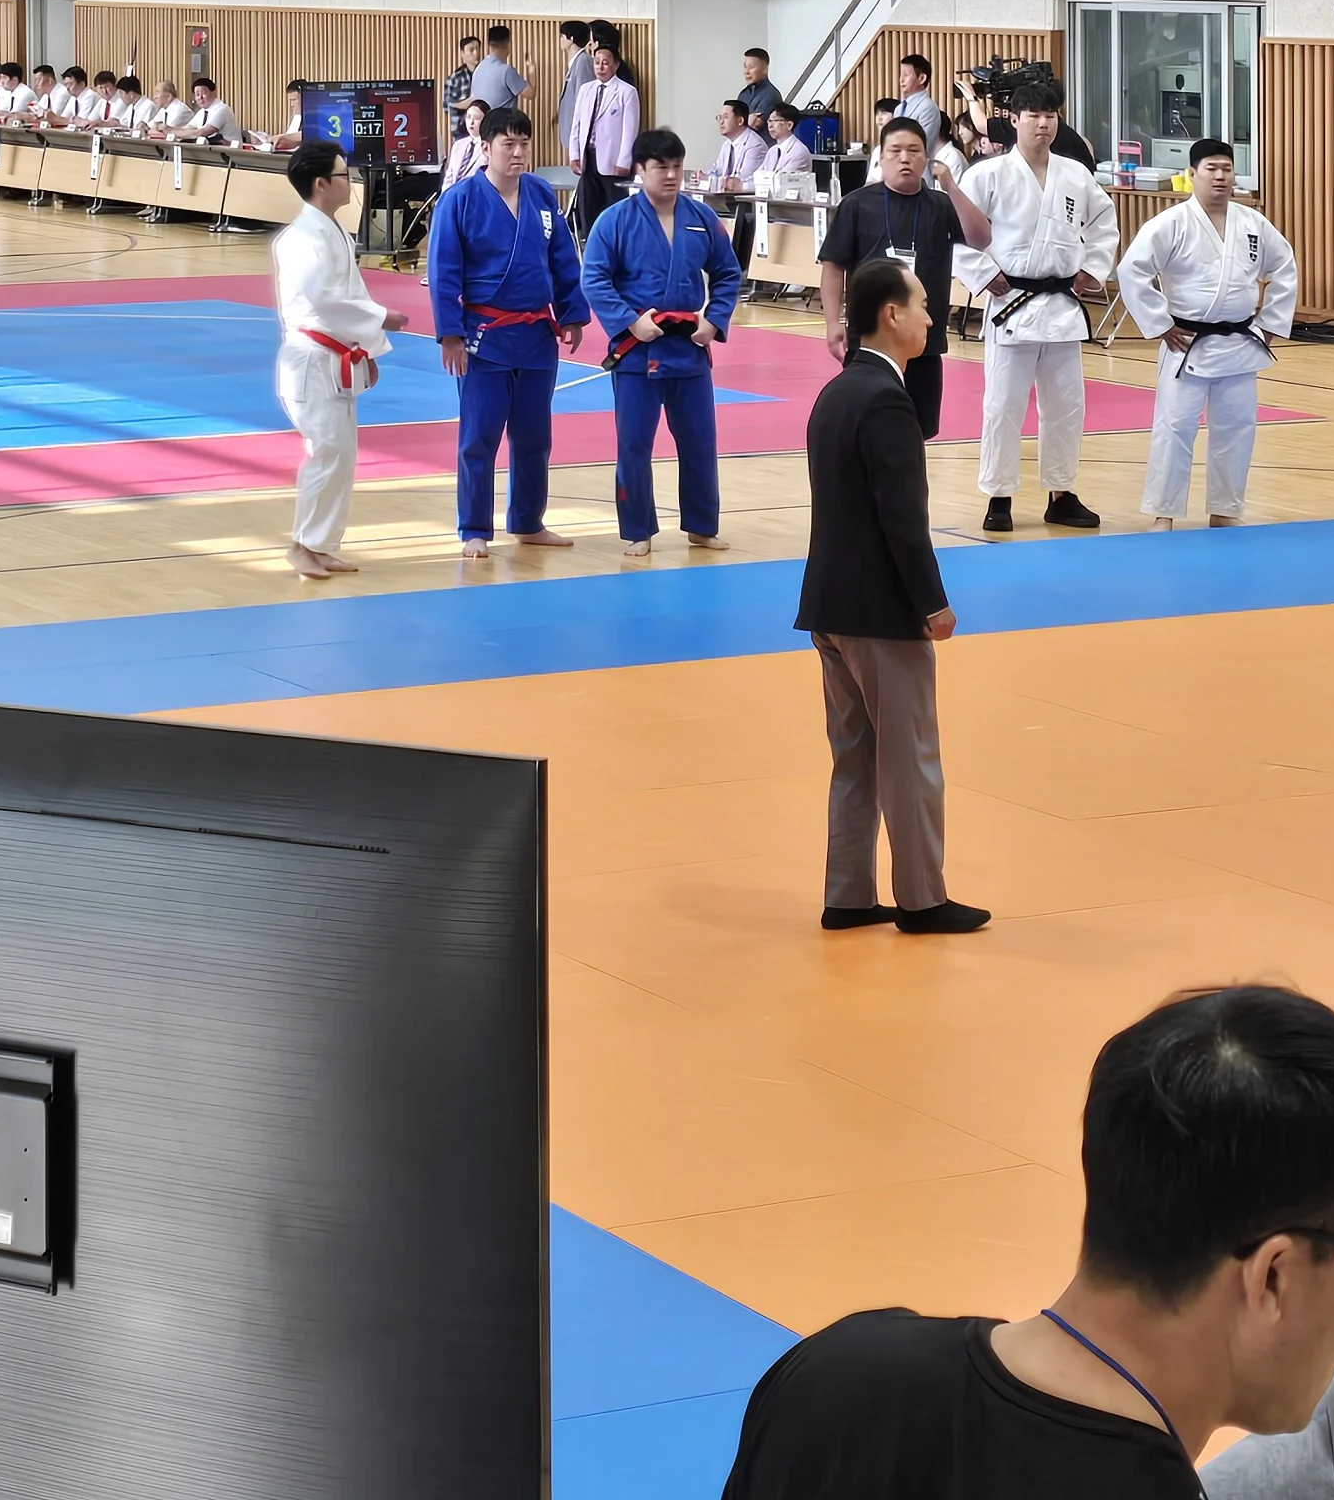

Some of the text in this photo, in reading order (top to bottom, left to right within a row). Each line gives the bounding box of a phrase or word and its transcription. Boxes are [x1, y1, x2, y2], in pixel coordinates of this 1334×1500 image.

[327, 115, 343, 138] 3
[355, 123, 382, 135] 0:17
[393, 113, 409, 137] 2
